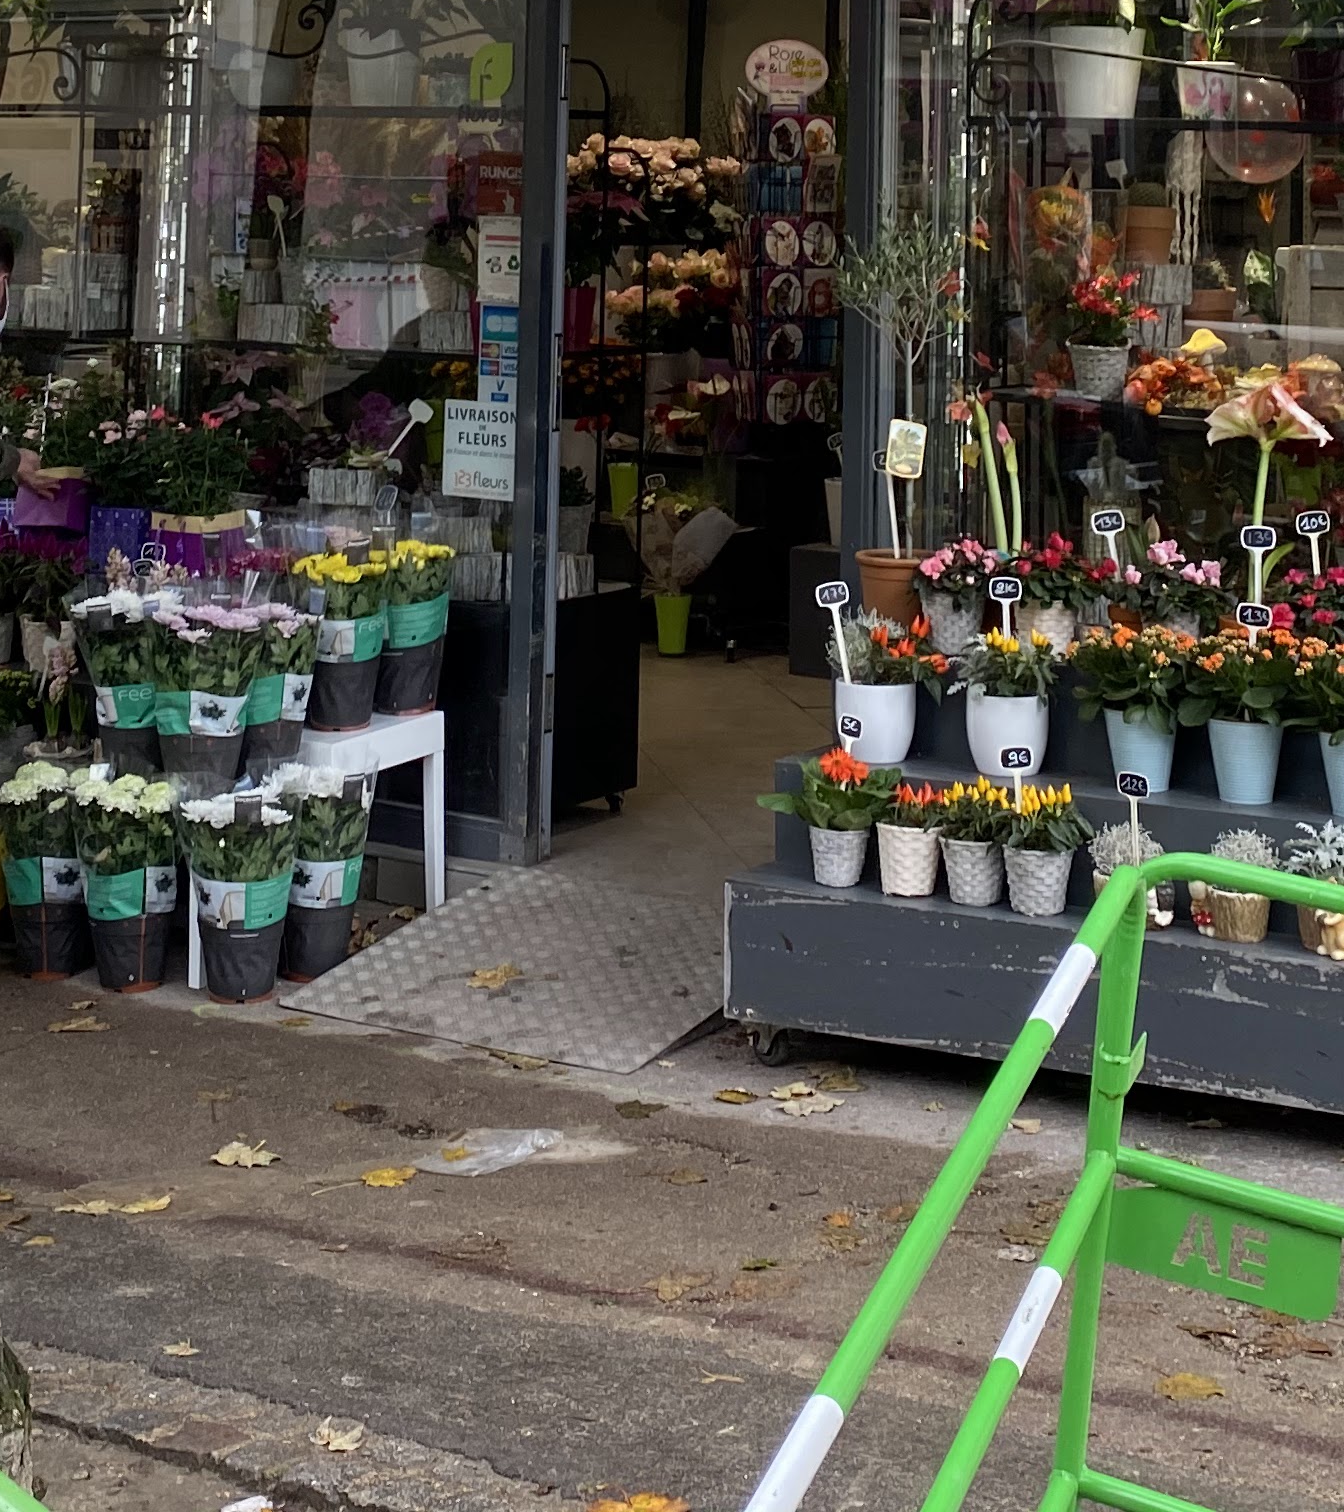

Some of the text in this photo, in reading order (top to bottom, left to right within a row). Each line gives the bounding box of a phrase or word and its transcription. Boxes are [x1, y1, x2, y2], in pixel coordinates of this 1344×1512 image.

[458, 432, 507, 447] FLEURS
[1299, 514, 1327, 531] 10€
[1121, 776, 1146, 792] 12€
[1170, 1211, 1271, 1291] AE
